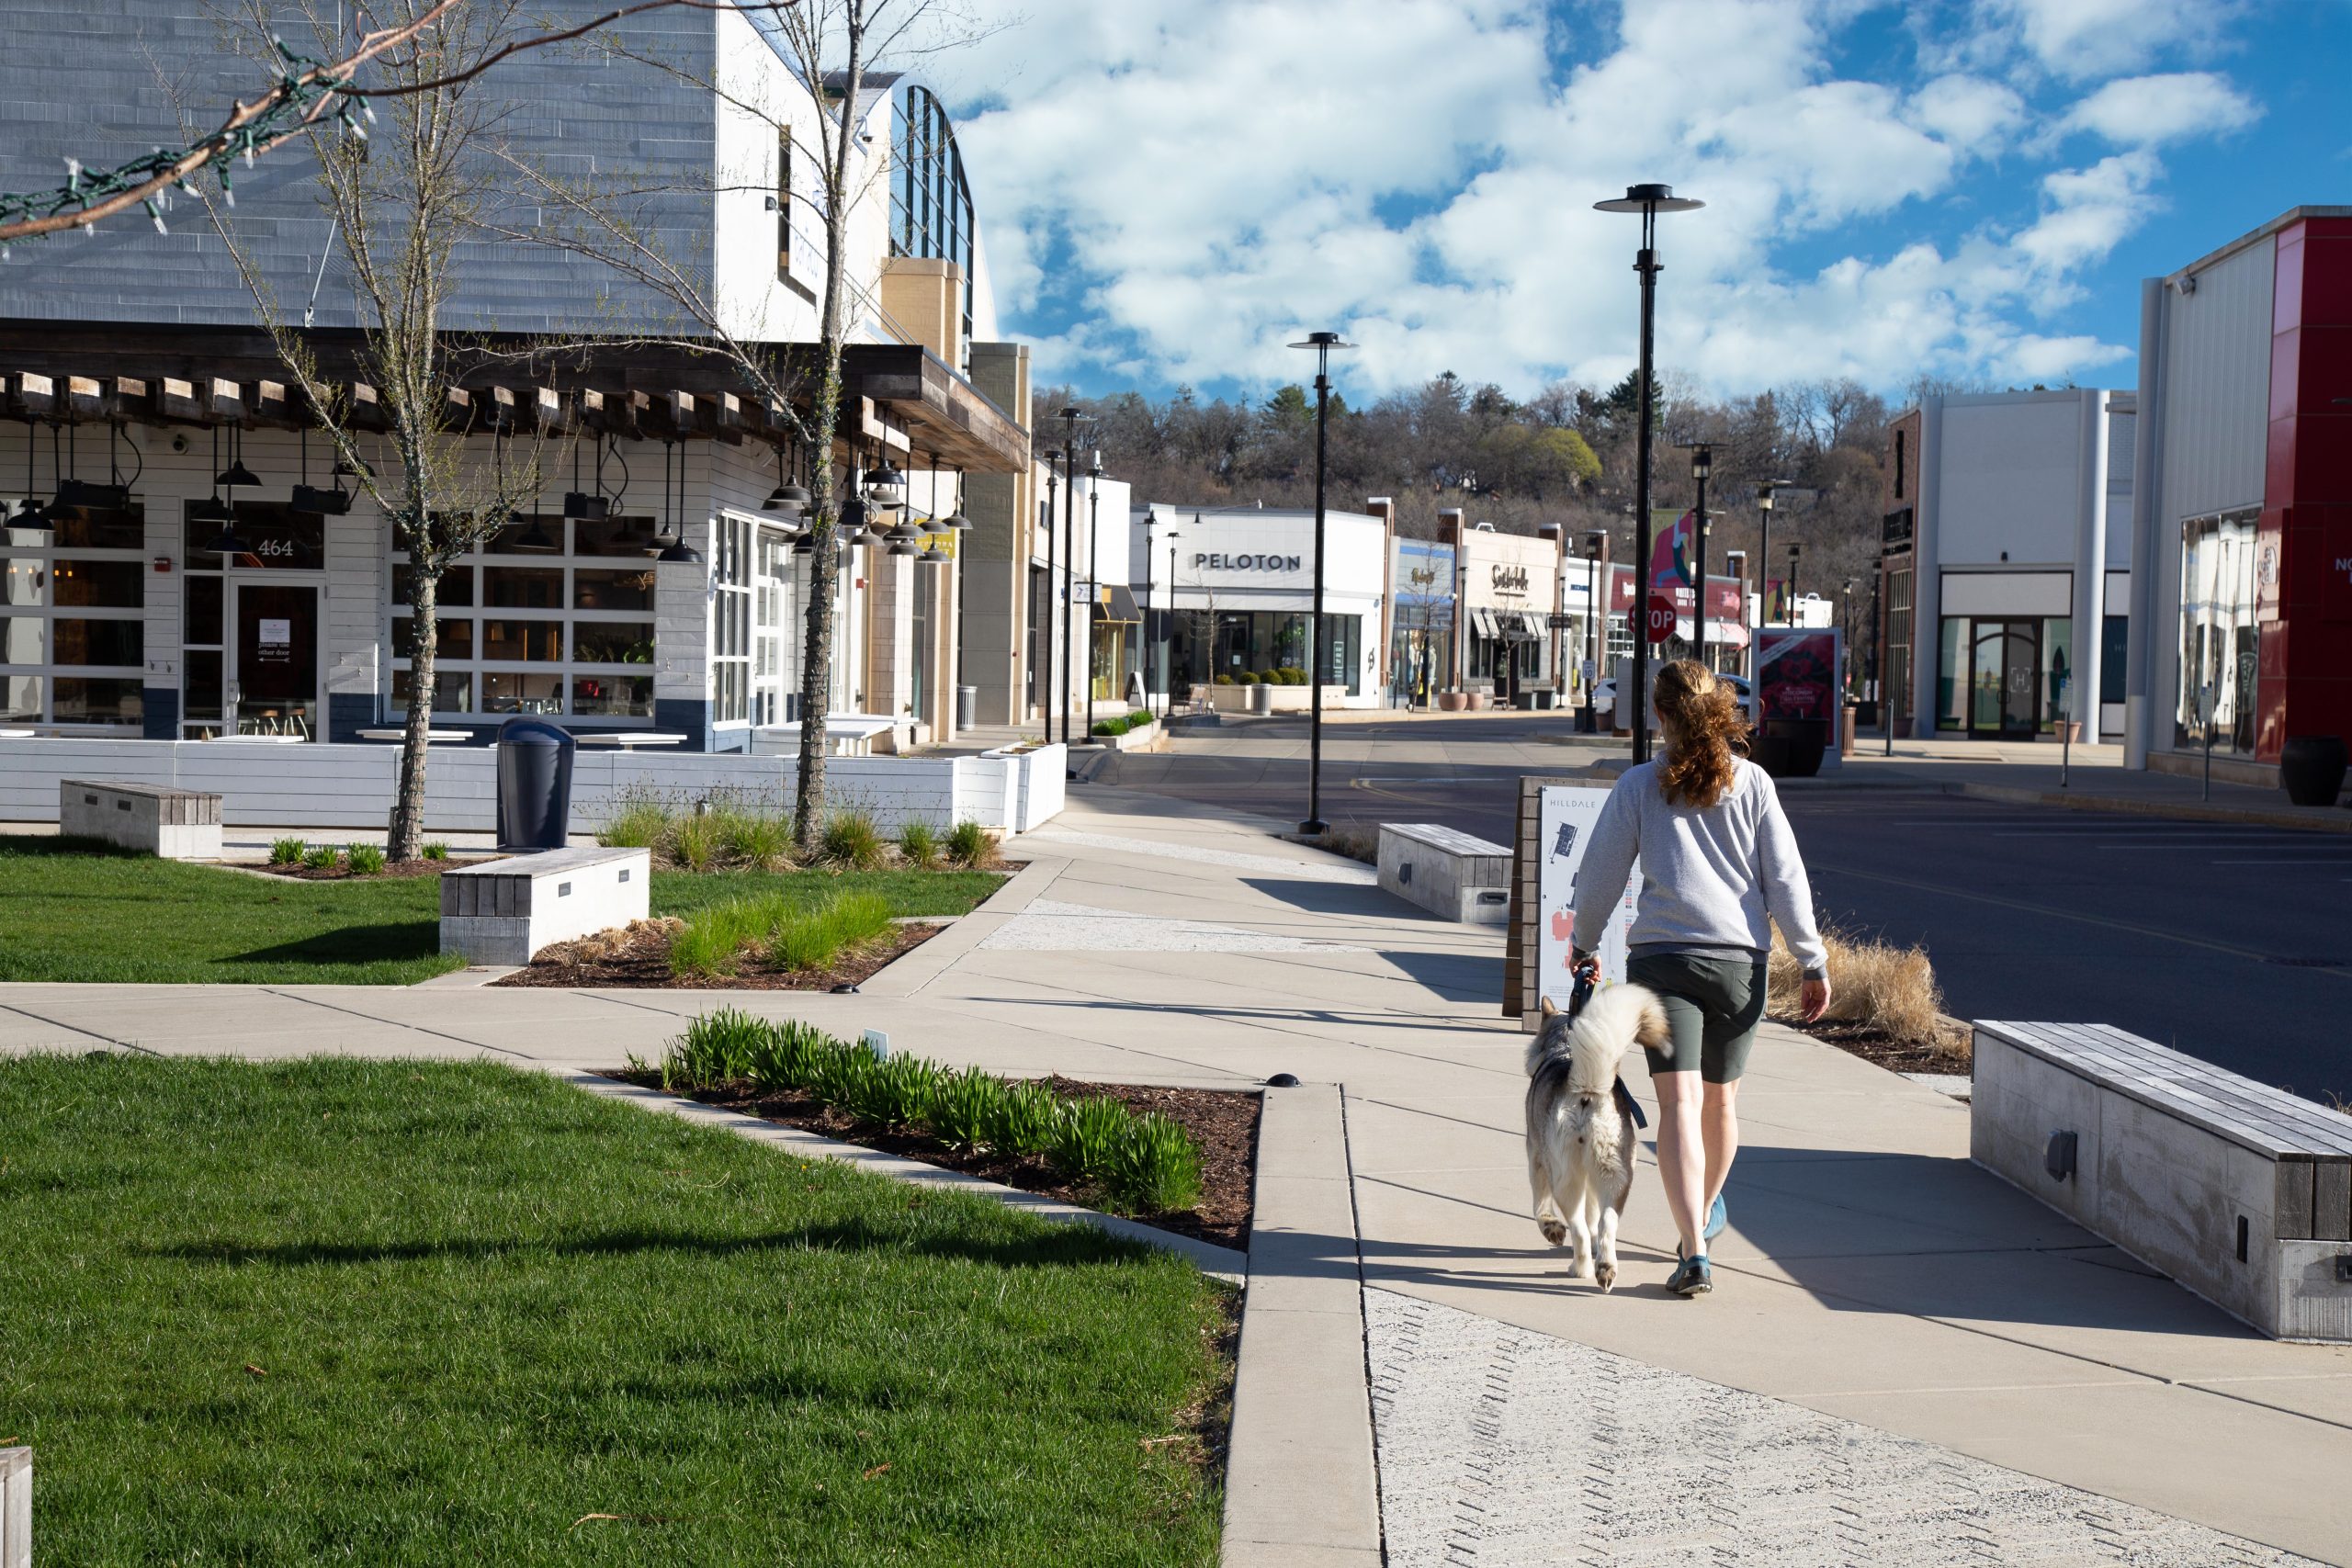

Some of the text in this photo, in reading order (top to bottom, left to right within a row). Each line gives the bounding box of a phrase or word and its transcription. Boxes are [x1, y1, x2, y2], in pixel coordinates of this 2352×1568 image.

[258, 539, 293, 557] 464
[1195, 553, 1300, 570] PELOTON
[1632, 610, 1674, 629] OP
[2016, 673, 2025, 685] H
[1550, 799, 1596, 808] HILLDALE
